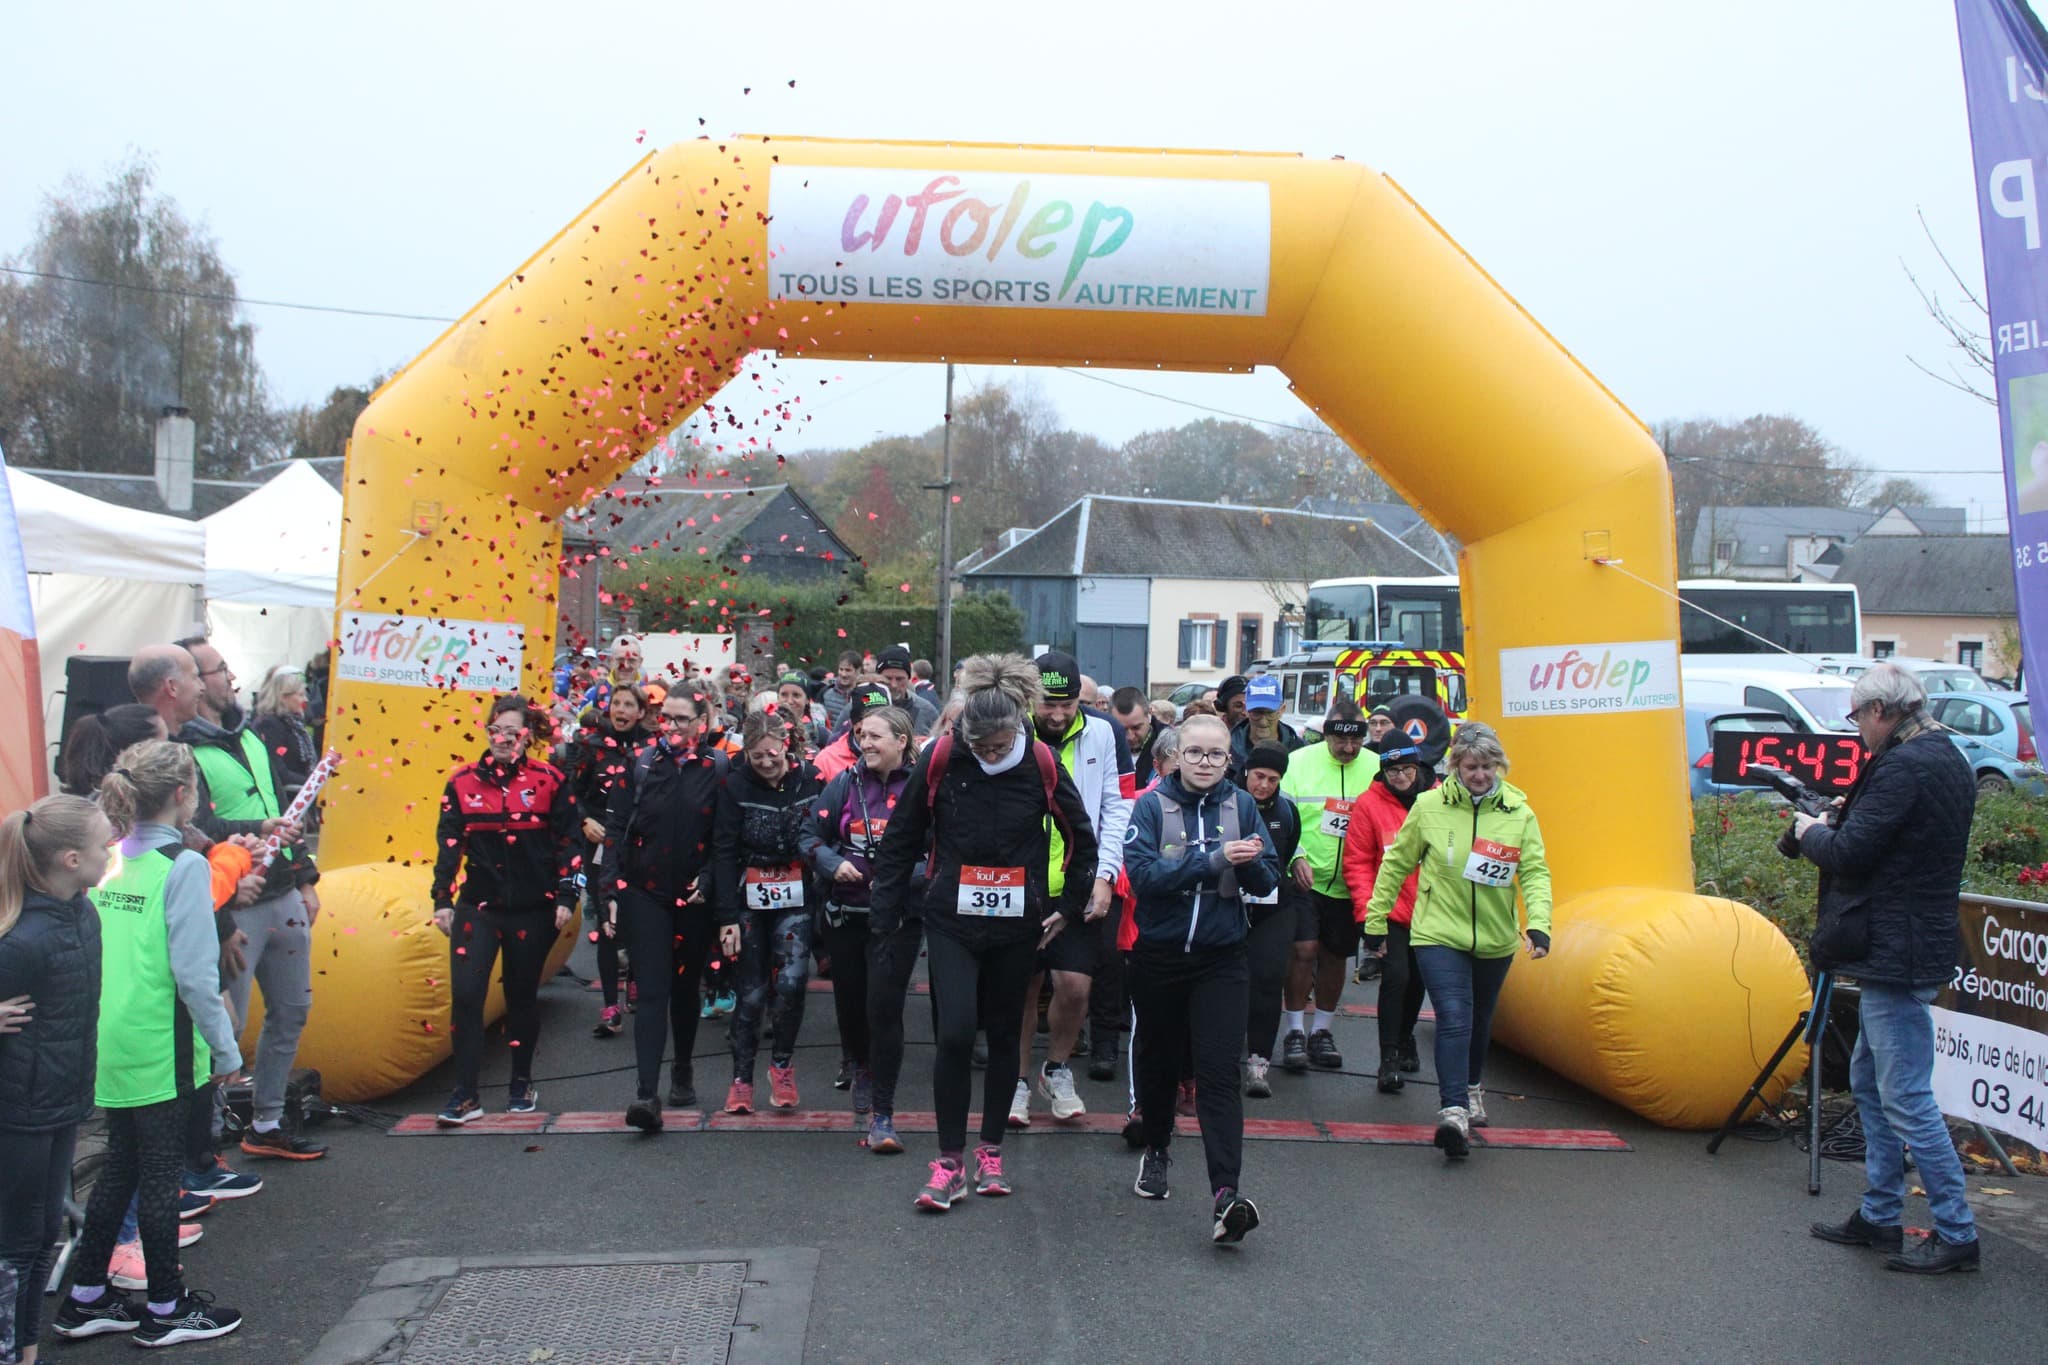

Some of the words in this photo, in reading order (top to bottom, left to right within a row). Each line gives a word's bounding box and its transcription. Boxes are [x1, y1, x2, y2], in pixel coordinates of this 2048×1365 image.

[841, 175, 1134, 301] ufolep
[778, 273, 858, 297] TOUS
[868, 275, 922, 298] LES
[932, 278, 1051, 302] SPORTS
[1075, 282, 1257, 310] AUTREMENT
[352, 619, 468, 675] ufolep
[379, 667, 430, 682] SPORTS
[1529, 649, 1651, 704] ufolep
[1508, 700, 1538, 712] TOUS
[1542, 699, 1567, 711] LES
[1571, 697, 1623, 709] SPORTS
[1476, 862, 1510, 880] 422
[758, 886, 792, 901] 361
[971, 891, 1011, 909] 391
[1977, 1043, 2000, 1068] rue
[2005, 1045, 2020, 1074] de
[2022, 1049, 2034, 1080] la
[1972, 1079, 2010, 1114] 03
[2018, 1095, 2046, 1131] 44
